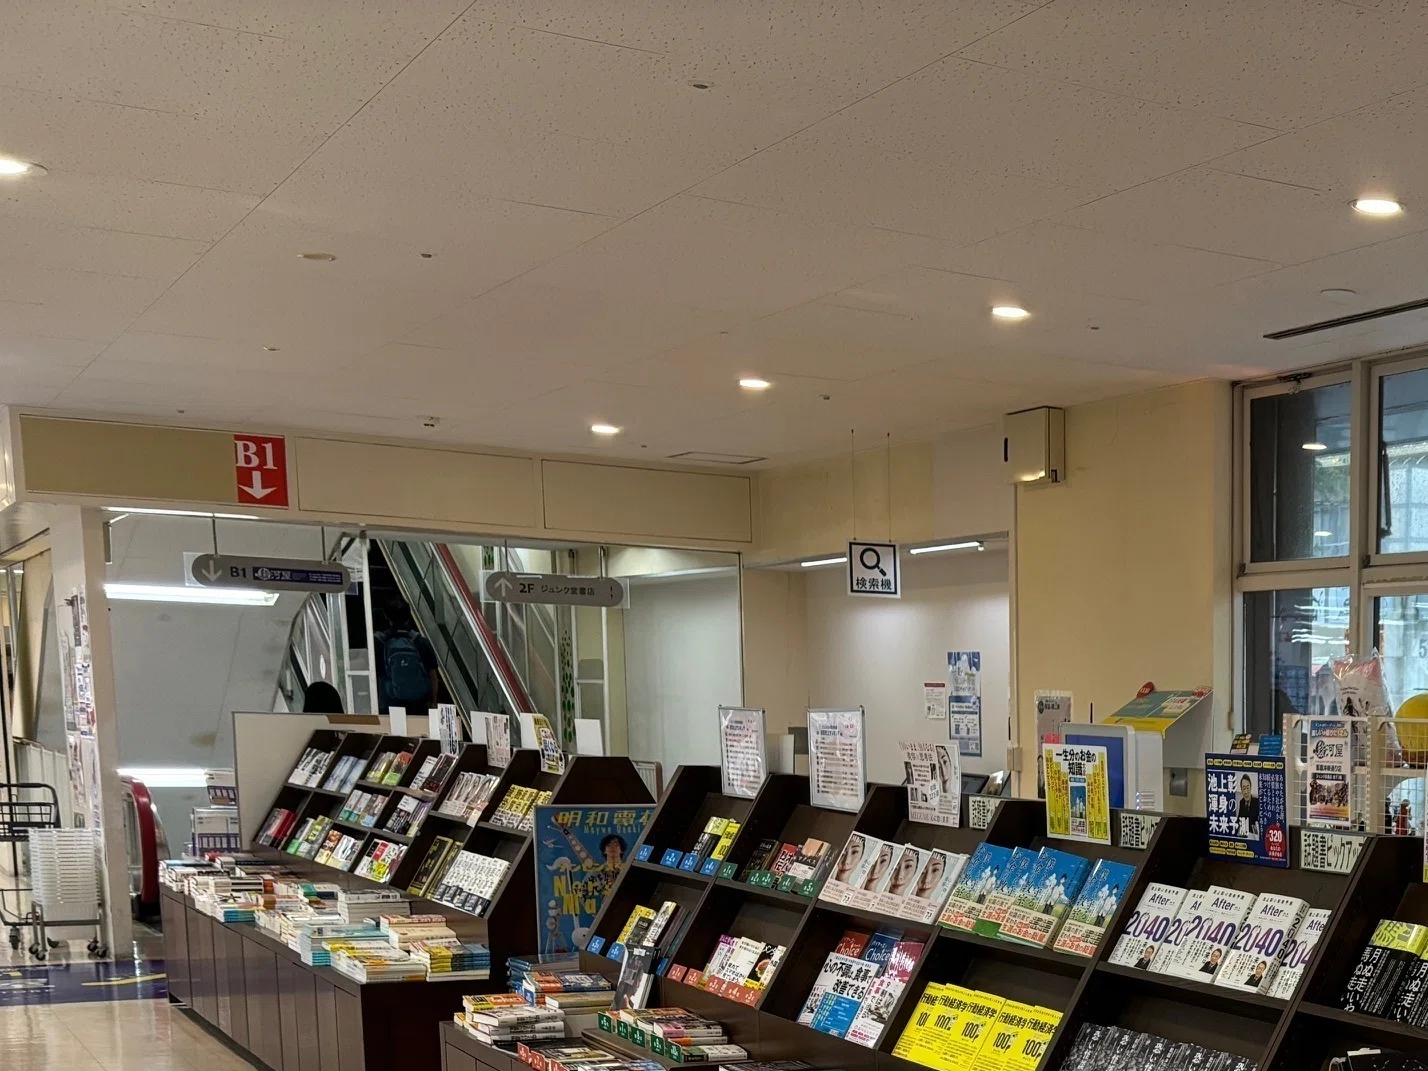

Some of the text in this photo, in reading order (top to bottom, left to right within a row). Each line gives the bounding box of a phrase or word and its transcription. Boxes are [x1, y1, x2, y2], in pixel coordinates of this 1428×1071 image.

[235, 440, 278, 470] B1
[230, 566, 247, 578] B1
[519, 583, 595, 596] 2F ジュンク堂書店
[855, 576, 892, 591] 検索機
[1055, 748, 1096, 763] 一生分のお金の
[1208, 773, 1237, 793] 池上彰
[1208, 794, 1237, 813] 渾身の
[1209, 814, 1249, 836] 未来予測
[1269, 830, 1282, 842] 320
[1149, 893, 1170, 906] After
[1211, 897, 1234, 911] After
[1260, 904, 1283, 917] After
[1124, 911, 1170, 942] 2040
[1186, 915, 1236, 947] 2040
[1233, 923, 1284, 957] 2040
[865, 947, 891, 961] Choice
[966, 1001, 998, 1019] 行動経済学
